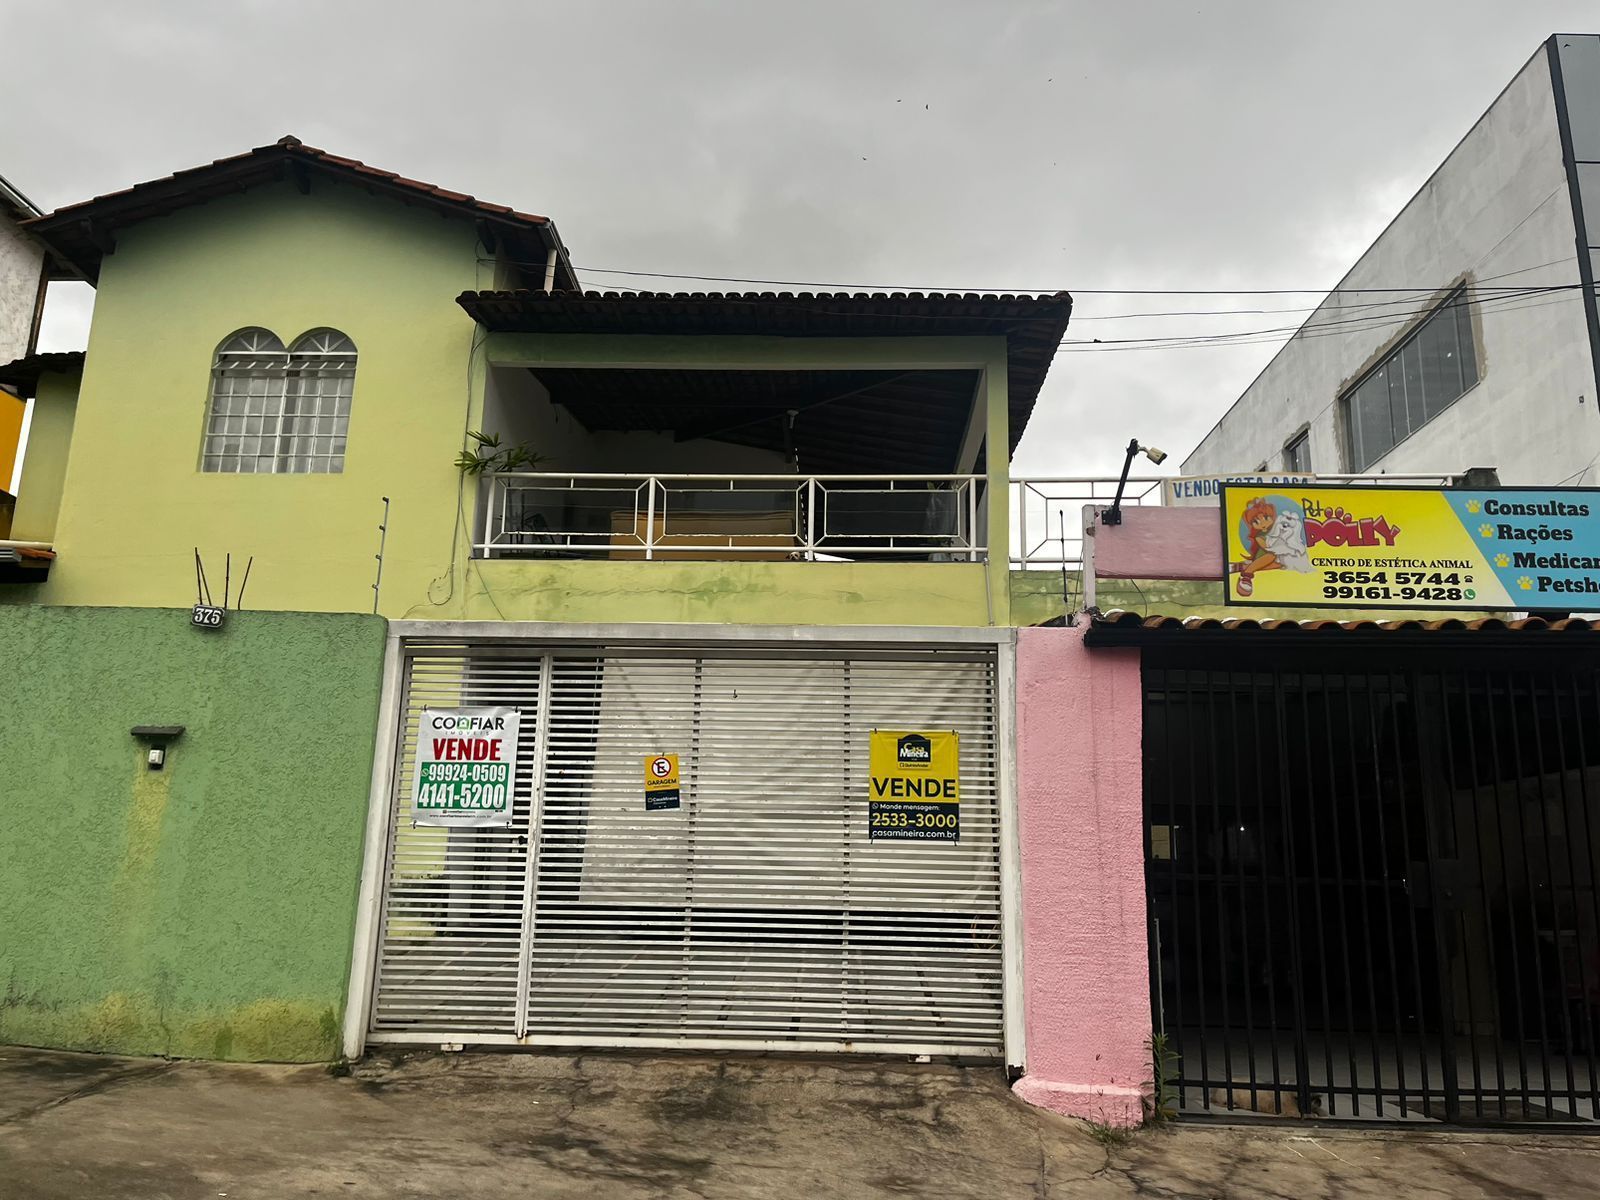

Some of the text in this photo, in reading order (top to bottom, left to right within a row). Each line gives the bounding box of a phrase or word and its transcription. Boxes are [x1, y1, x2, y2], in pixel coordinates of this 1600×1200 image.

[1172, 478, 1220, 498] VENDO
[1301, 497, 1324, 518] Pet
[1484, 499, 1590, 516] Consultas
[1302, 513, 1401, 548] POLLY
[1497, 523, 1573, 545] Rações
[1311, 556, 1473, 569] CENTRO DE ESTÉTICA ANIMAL
[1323, 571, 1461, 585] 3654 5744
[1537, 576, 1600, 593] Petsh
[1322, 585, 1463, 601] 99161-9428
[194, 607, 222, 625] 375
[433, 738, 503, 761] VENDE
[903, 742, 925, 752] Casa
[428, 763, 507, 782] 99924-0509
[647, 778, 677, 786] GARAGEM
[872, 777, 956, 798] VENDE
[418, 783, 505, 808] 4141-5200
[872, 812, 957, 828] 2533-3000
[872, 829, 956, 839] casamineira.com.br
